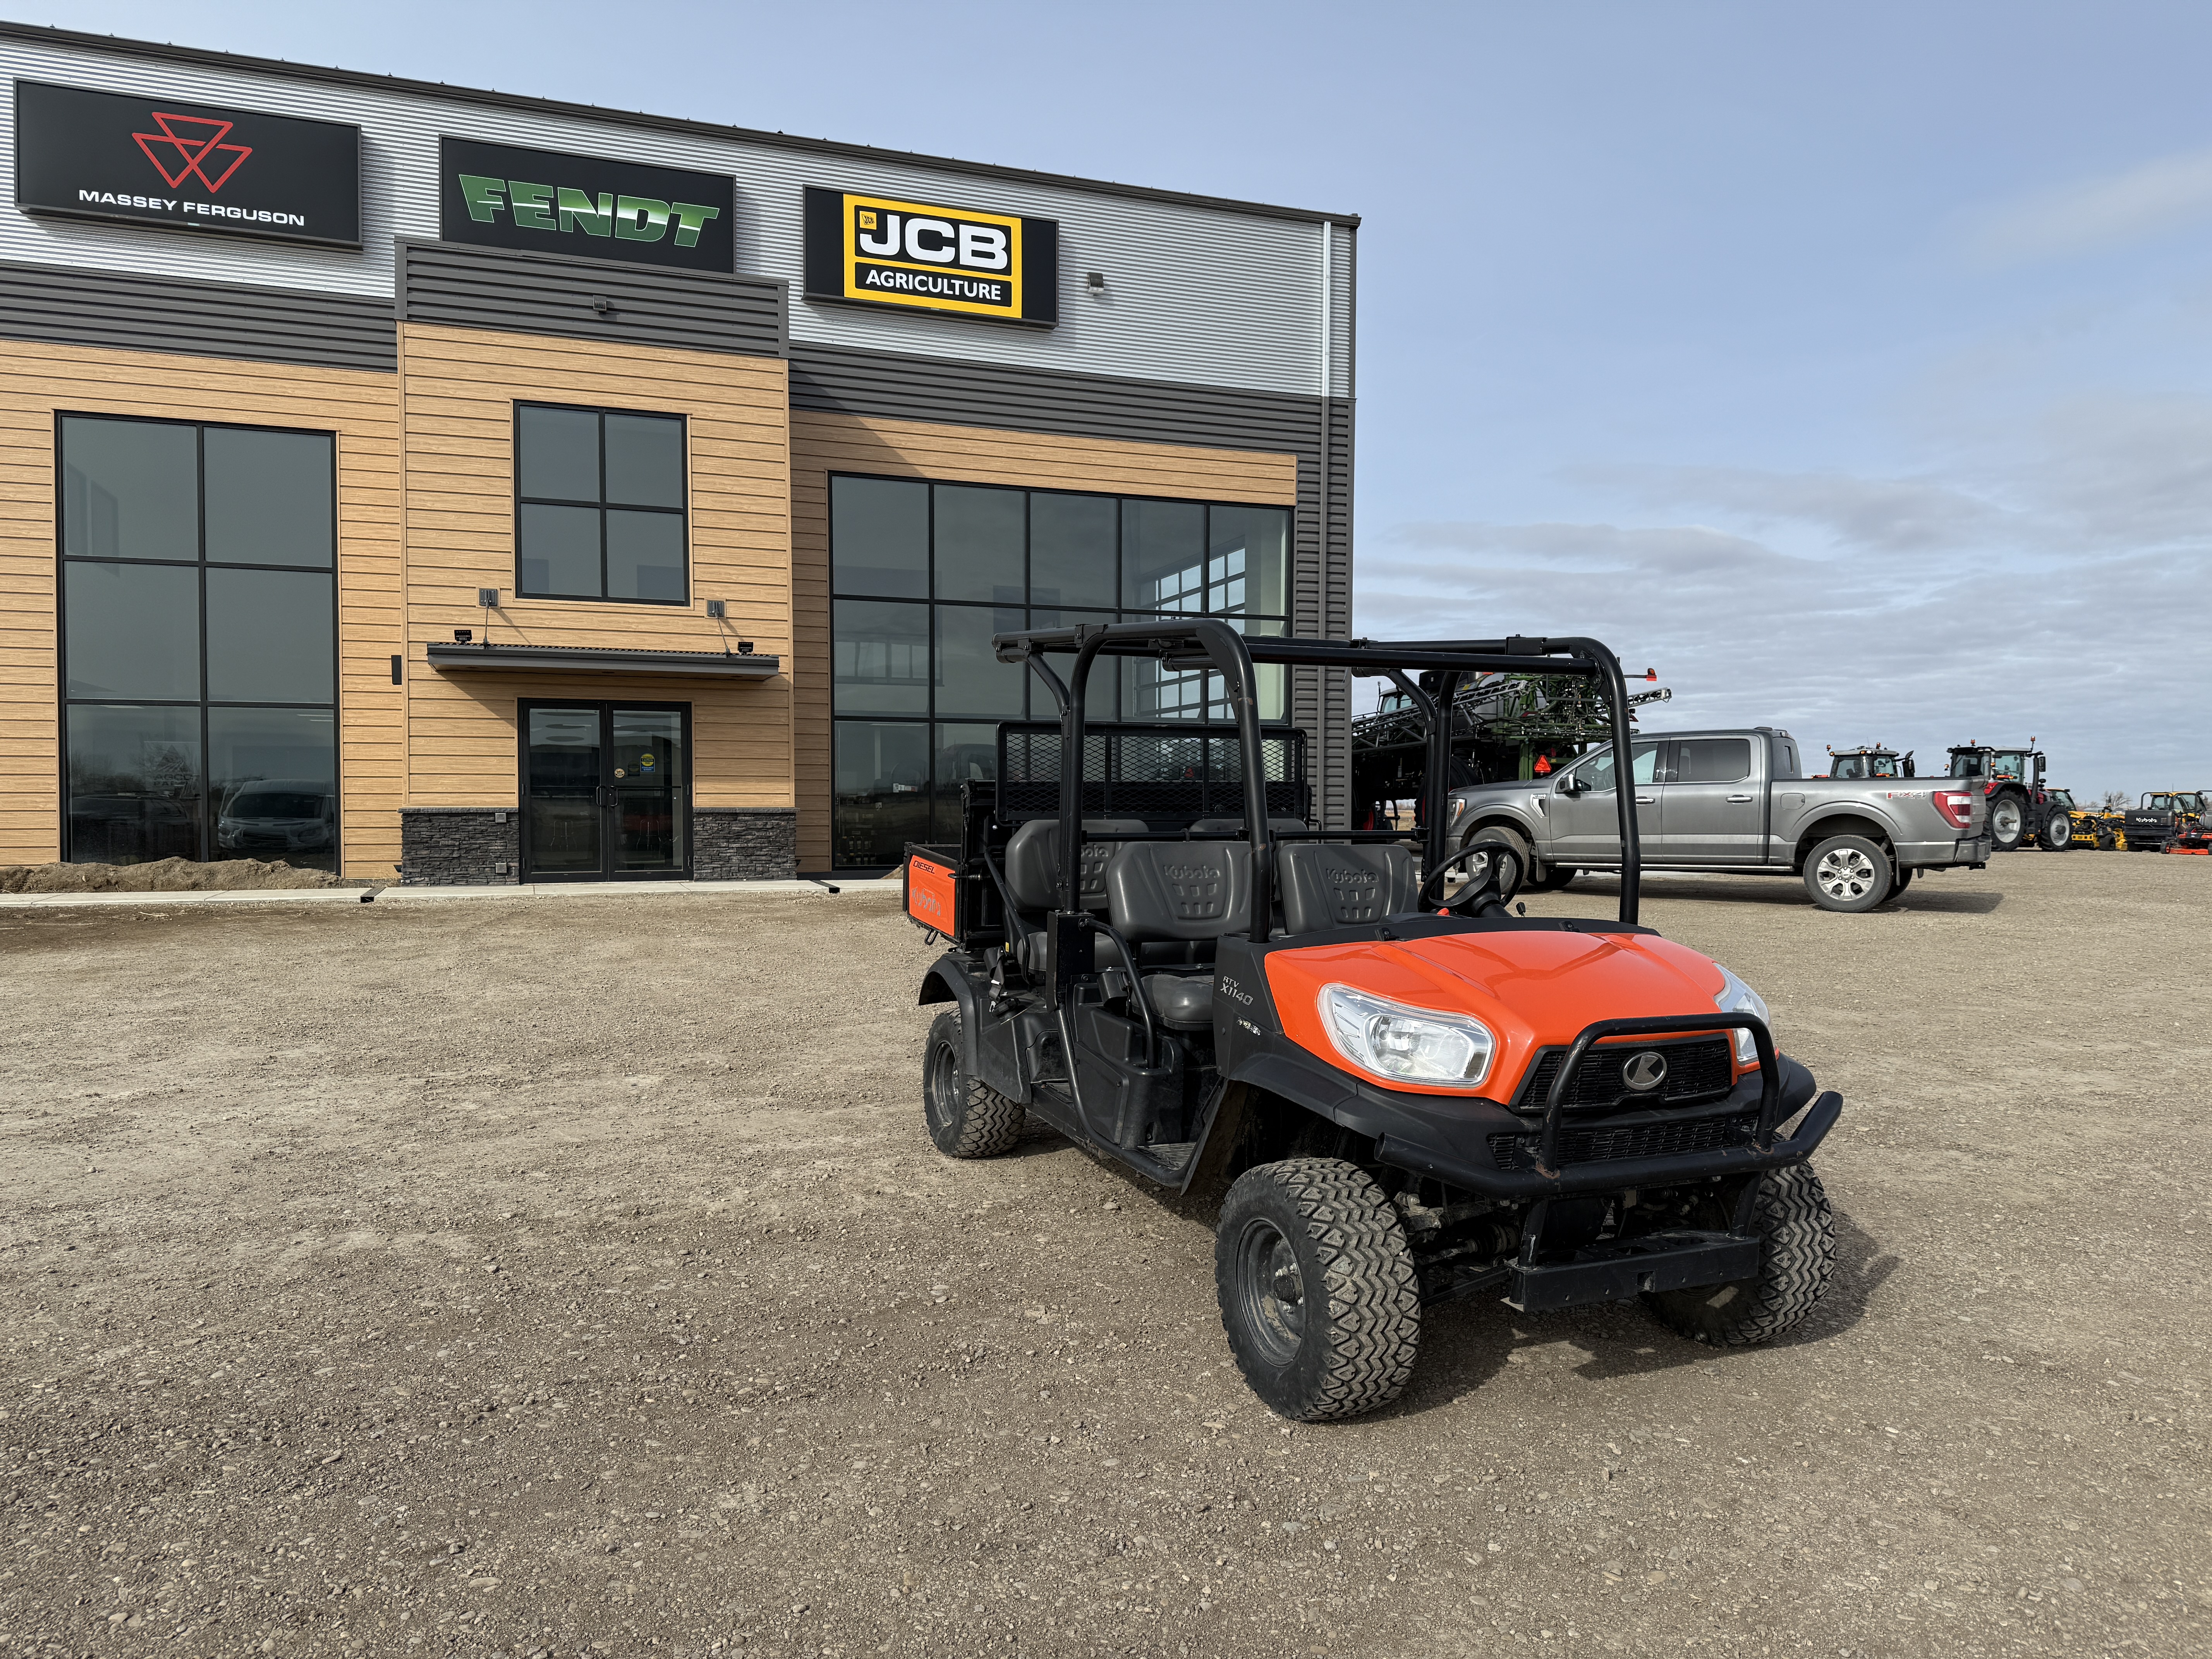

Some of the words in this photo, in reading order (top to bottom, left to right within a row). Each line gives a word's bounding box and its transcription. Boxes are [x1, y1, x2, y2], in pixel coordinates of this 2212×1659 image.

[79, 189, 177, 212] MASSEY
[183, 201, 304, 226] FERGUSON
[459, 174, 720, 248] FENDT
[864, 215, 874, 224] JCB
[859, 214, 1008, 270] JCB
[865, 269, 1001, 301] AGRICULTURE
[913, 860, 935, 874] DIESEL
[1163, 864, 1221, 879] Kubota
[1326, 868, 1379, 883] Kubota
[1223, 975, 1239, 988] RTV
[1220, 982, 1254, 1005] X1140
